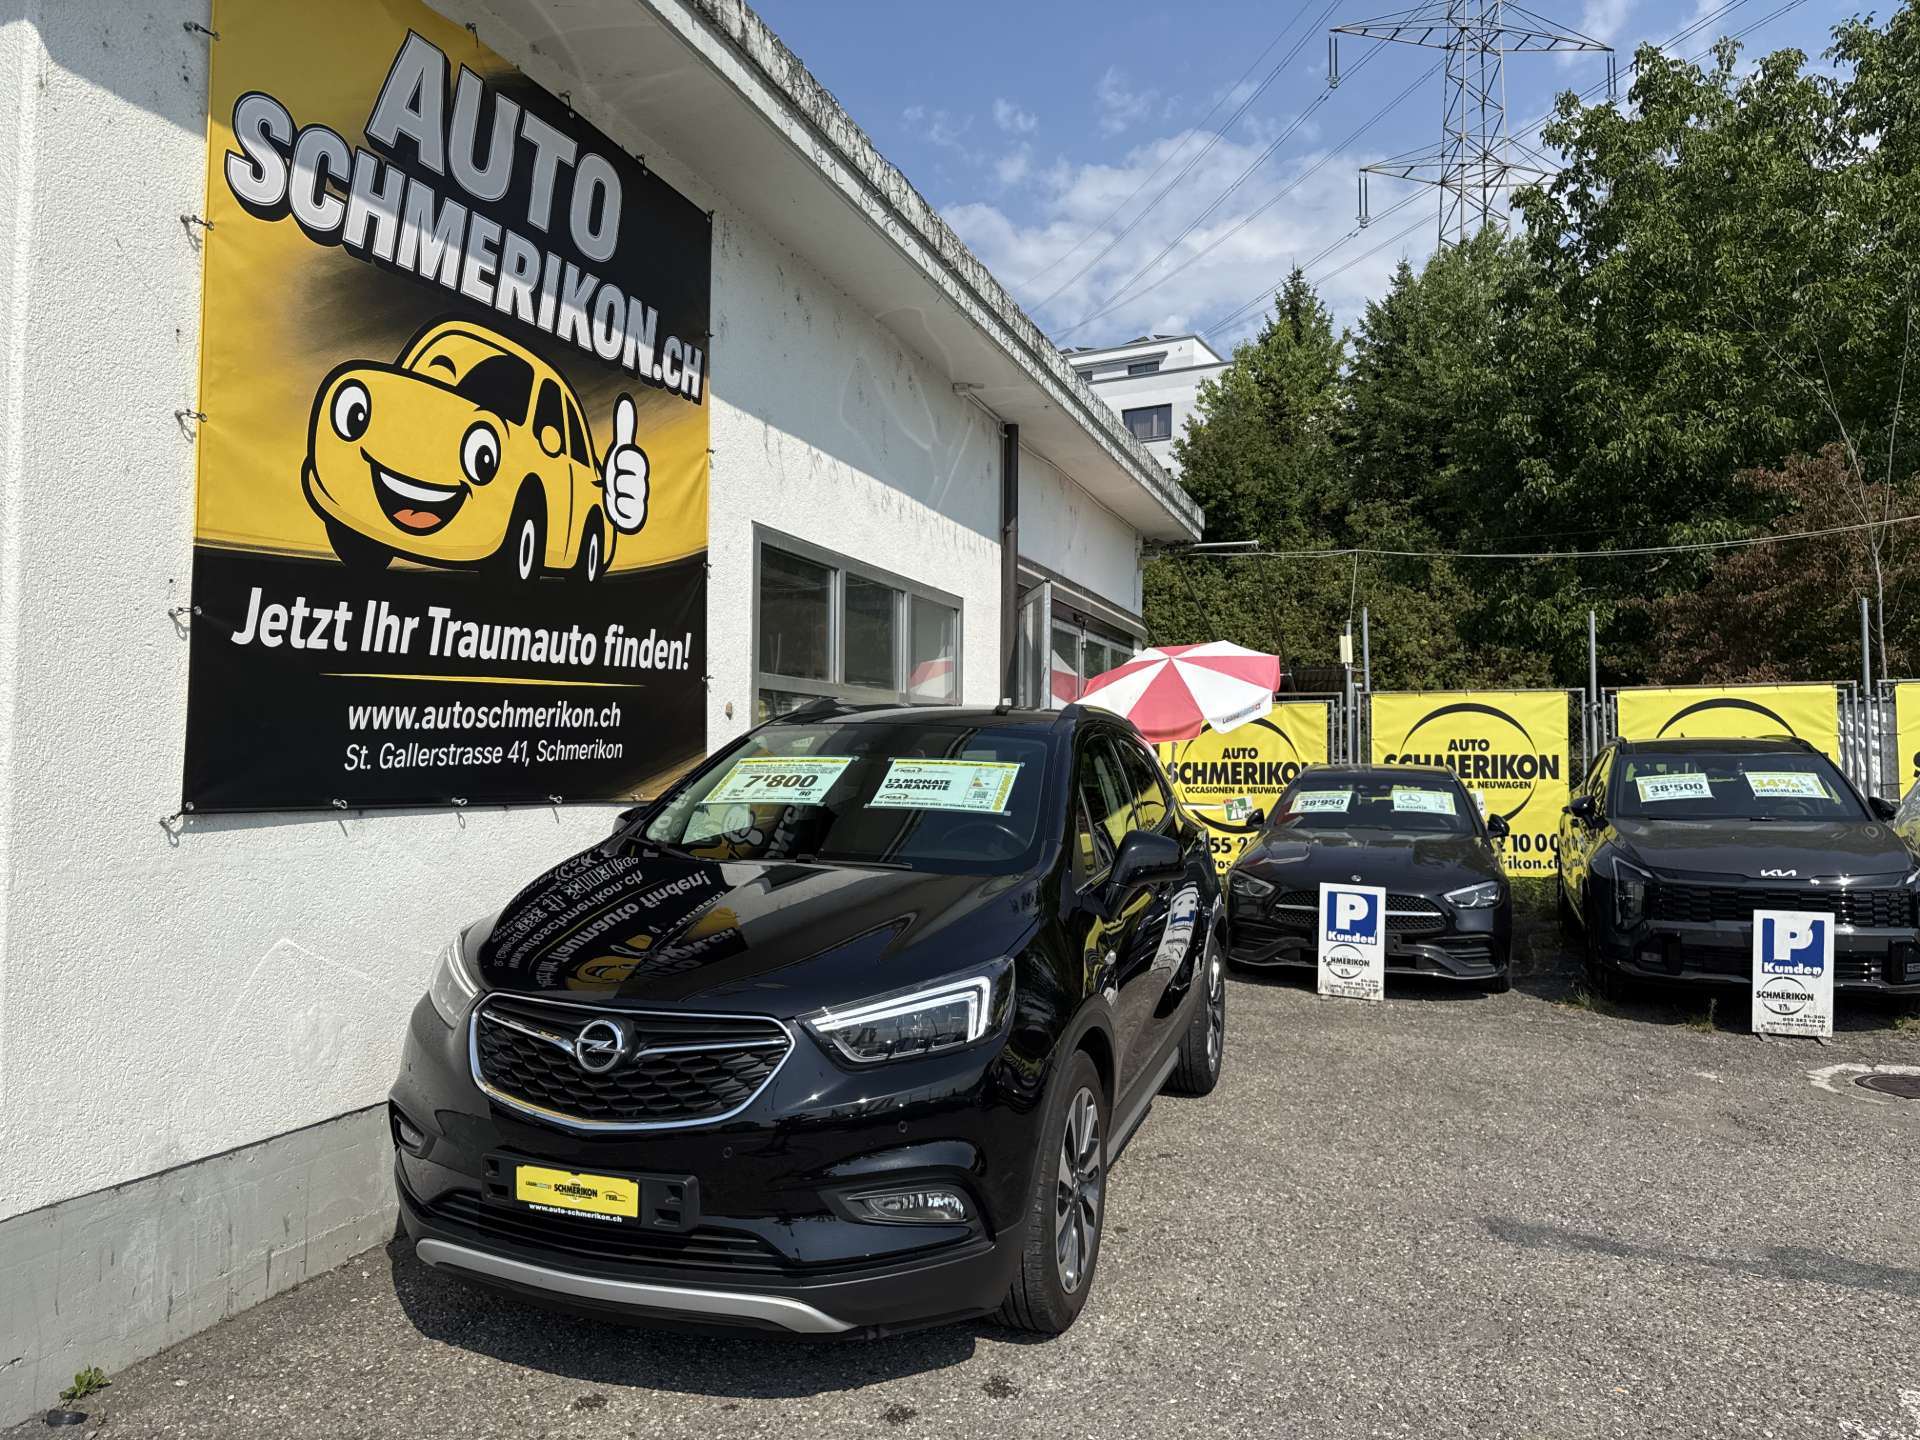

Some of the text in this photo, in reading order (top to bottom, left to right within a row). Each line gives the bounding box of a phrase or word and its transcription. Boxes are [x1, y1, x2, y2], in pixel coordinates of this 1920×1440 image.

[363, 29, 624, 263] AUTO
[227, 94, 704, 400] SCHMERIKON.CH
[231, 587, 692, 671] Jetzt Ihr Traumauto finden!
[347, 699, 622, 731] www.autoschmerikon.ch
[1447, 738, 1490, 752] AUTO
[343, 738, 624, 771] St. Gallerstrasse 41, Schmerikon
[1222, 747, 1259, 760] AUTO
[1166, 761, 1319, 785] SCHMERIKO
[744, 774, 820, 788] 7'800
[884, 783, 950, 791] GARANTIE
[902, 778, 953, 786] MONATE
[1650, 782, 1704, 793] 38'500
[1185, 786, 1235, 794] OCCASIONEN
[1247, 786, 1286, 795] NEUWAG
[1301, 798, 1344, 807] 38'950
[1210, 837, 1232, 854] 55
[1335, 893, 1369, 930] P
[1327, 931, 1376, 944] Kunden
[1322, 955, 1370, 967] SHMERIKON
[1763, 961, 1822, 976] Kunden
[1755, 990, 1815, 1001] SCHMERIKON
[553, 1184, 598, 1198] SCHMERIKON
[528, 1203, 623, 1223] www.auto-schmerikon.ch
